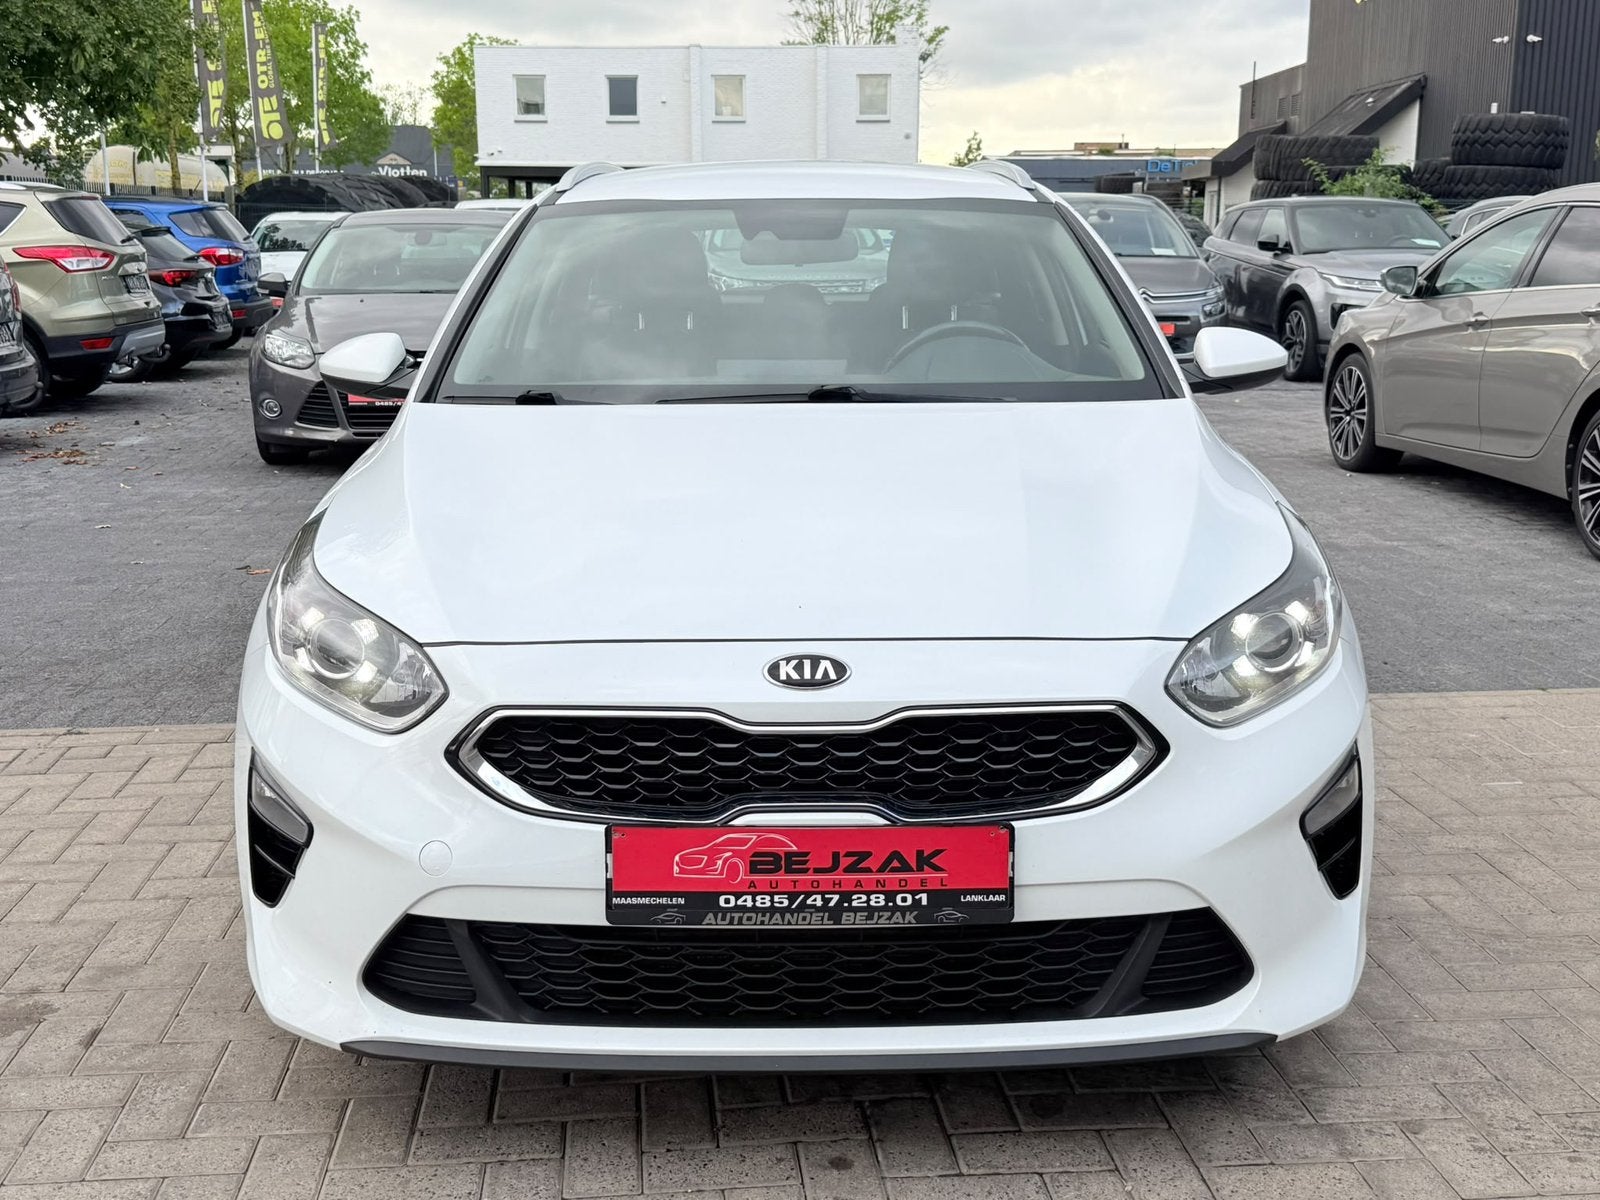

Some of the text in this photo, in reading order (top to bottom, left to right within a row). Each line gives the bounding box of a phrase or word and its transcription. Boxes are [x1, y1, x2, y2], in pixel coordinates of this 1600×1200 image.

[266, 61, 275, 88] GLOBAL
[378, 165, 428, 177] Vlotten
[779, 659, 837, 680] KIA
[749, 849, 948, 874] BEJZAK
[748, 878, 948, 890] AUTOHANDEL
[612, 897, 685, 905] MAASMECHELEN
[718, 893, 928, 909] 0485/47.28.01
[960, 894, 1006, 902] LANKLAAR
[702, 911, 919, 926] AUTOHANDEL BEJZAK
